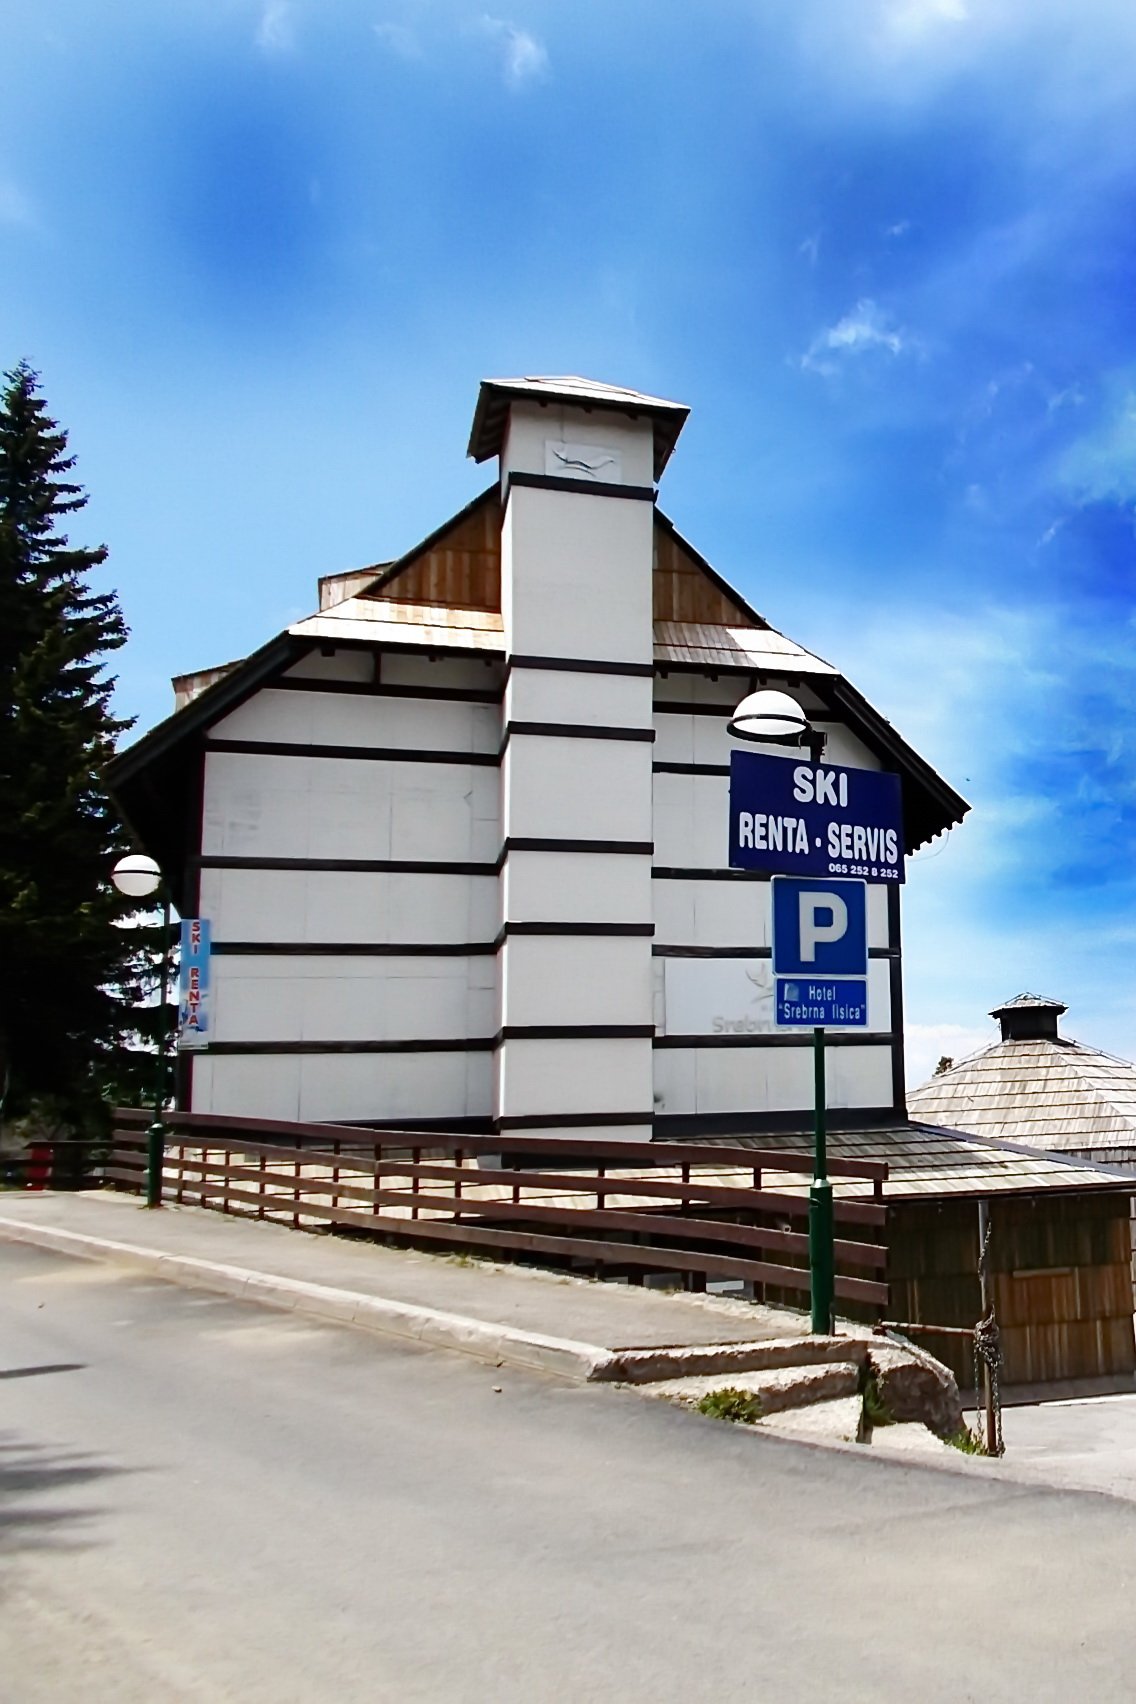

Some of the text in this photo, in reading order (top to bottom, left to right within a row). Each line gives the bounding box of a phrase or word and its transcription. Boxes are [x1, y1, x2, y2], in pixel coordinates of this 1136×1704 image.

[793, 766, 848, 807] SKI
[739, 811, 898, 864] RENTA SERVIS
[828, 863, 899, 879] 065 252 8 252
[799, 891, 848, 962] P
[188, 921, 201, 1025] SKI RENTA
[809, 985, 836, 1001] Hotel
